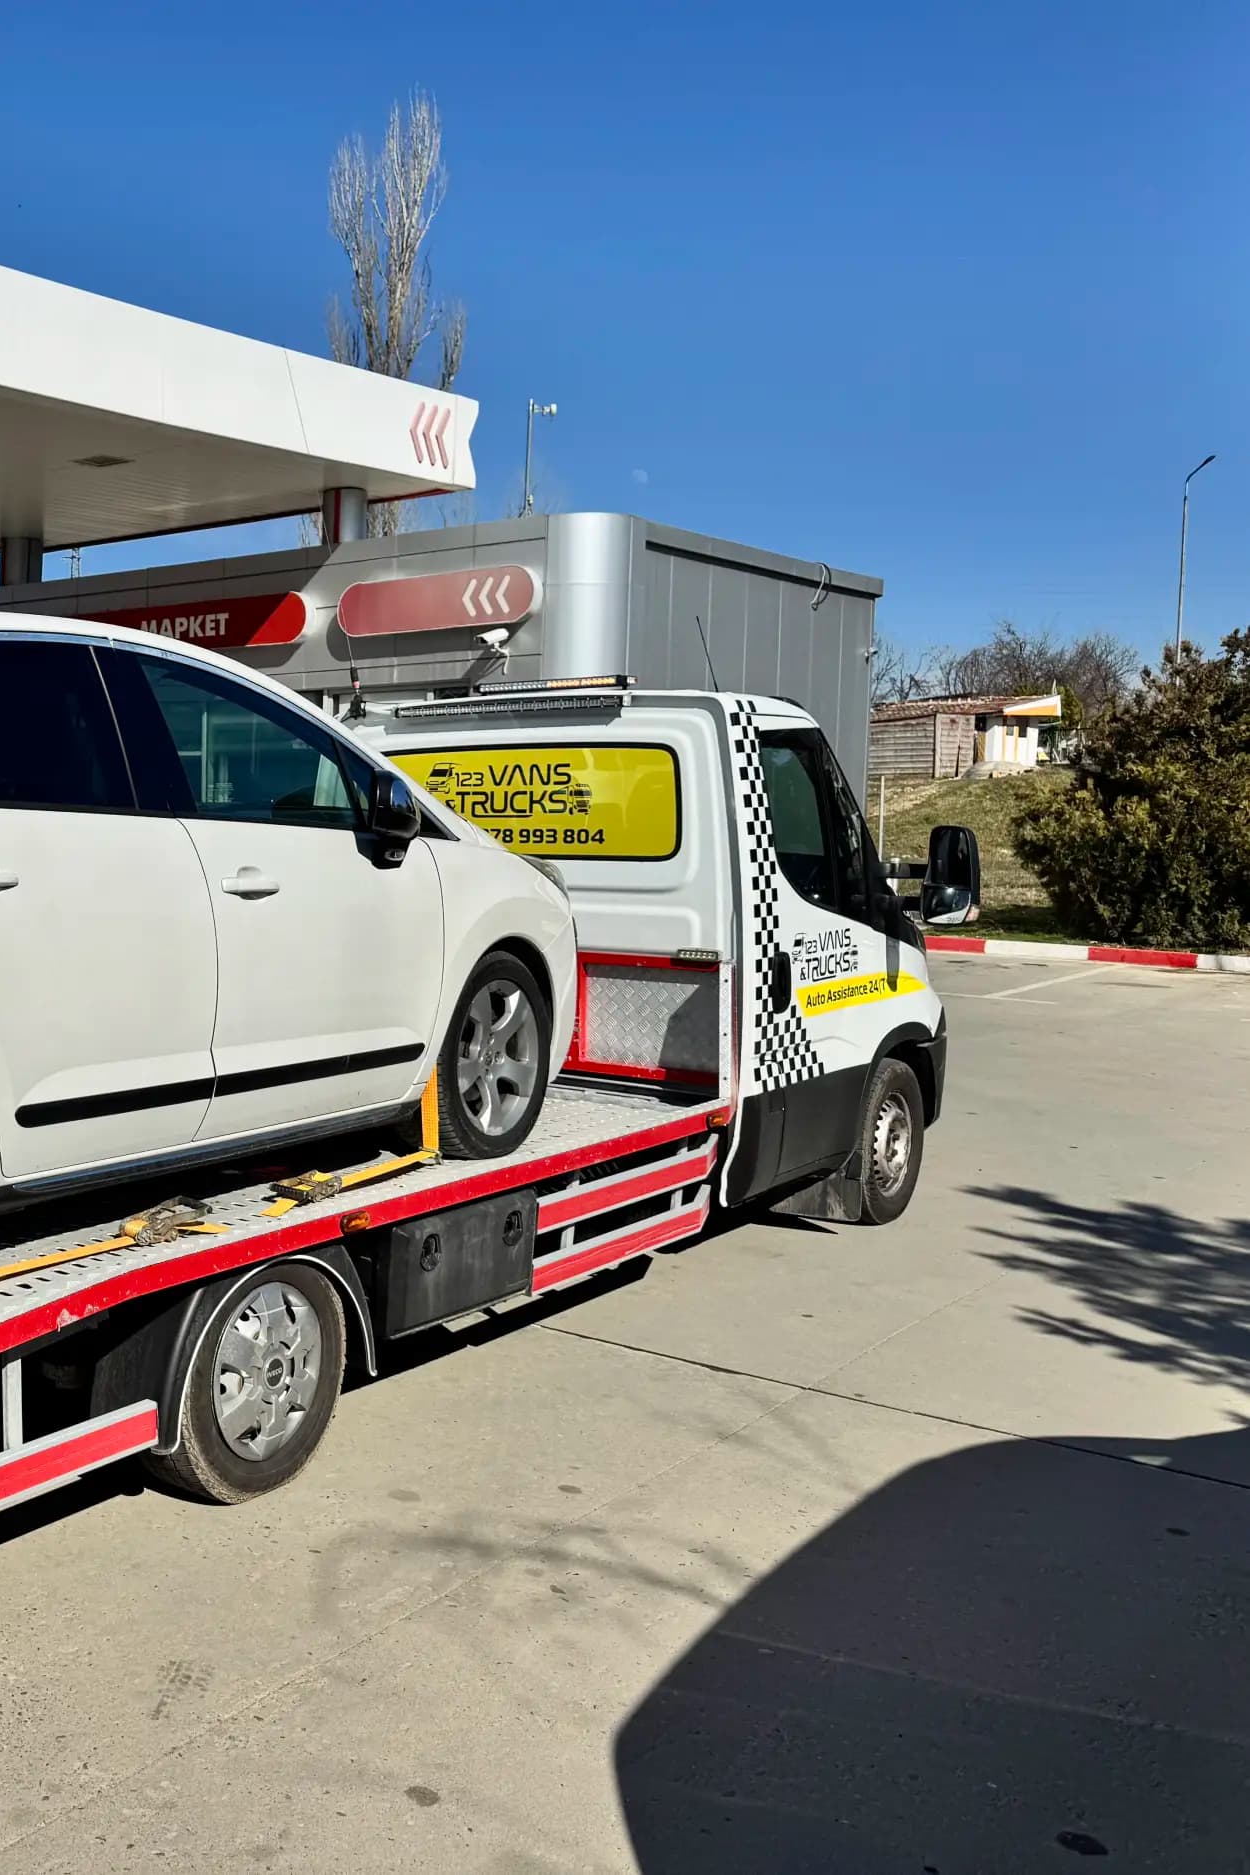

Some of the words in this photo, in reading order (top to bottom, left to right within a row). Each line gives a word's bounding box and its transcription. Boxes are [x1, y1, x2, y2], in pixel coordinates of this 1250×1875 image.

[140, 612, 229, 639] МАРКЕТ
[455, 772, 484, 787] 123
[488, 763, 572, 786] VANS
[518, 828, 558, 844] 993
[563, 828, 605, 844] 804
[818, 928, 851, 952] VANS
[806, 992, 826, 1009] Auto
[827, 983, 868, 1004] Assistance
[869, 977, 886, 996] 24/7
